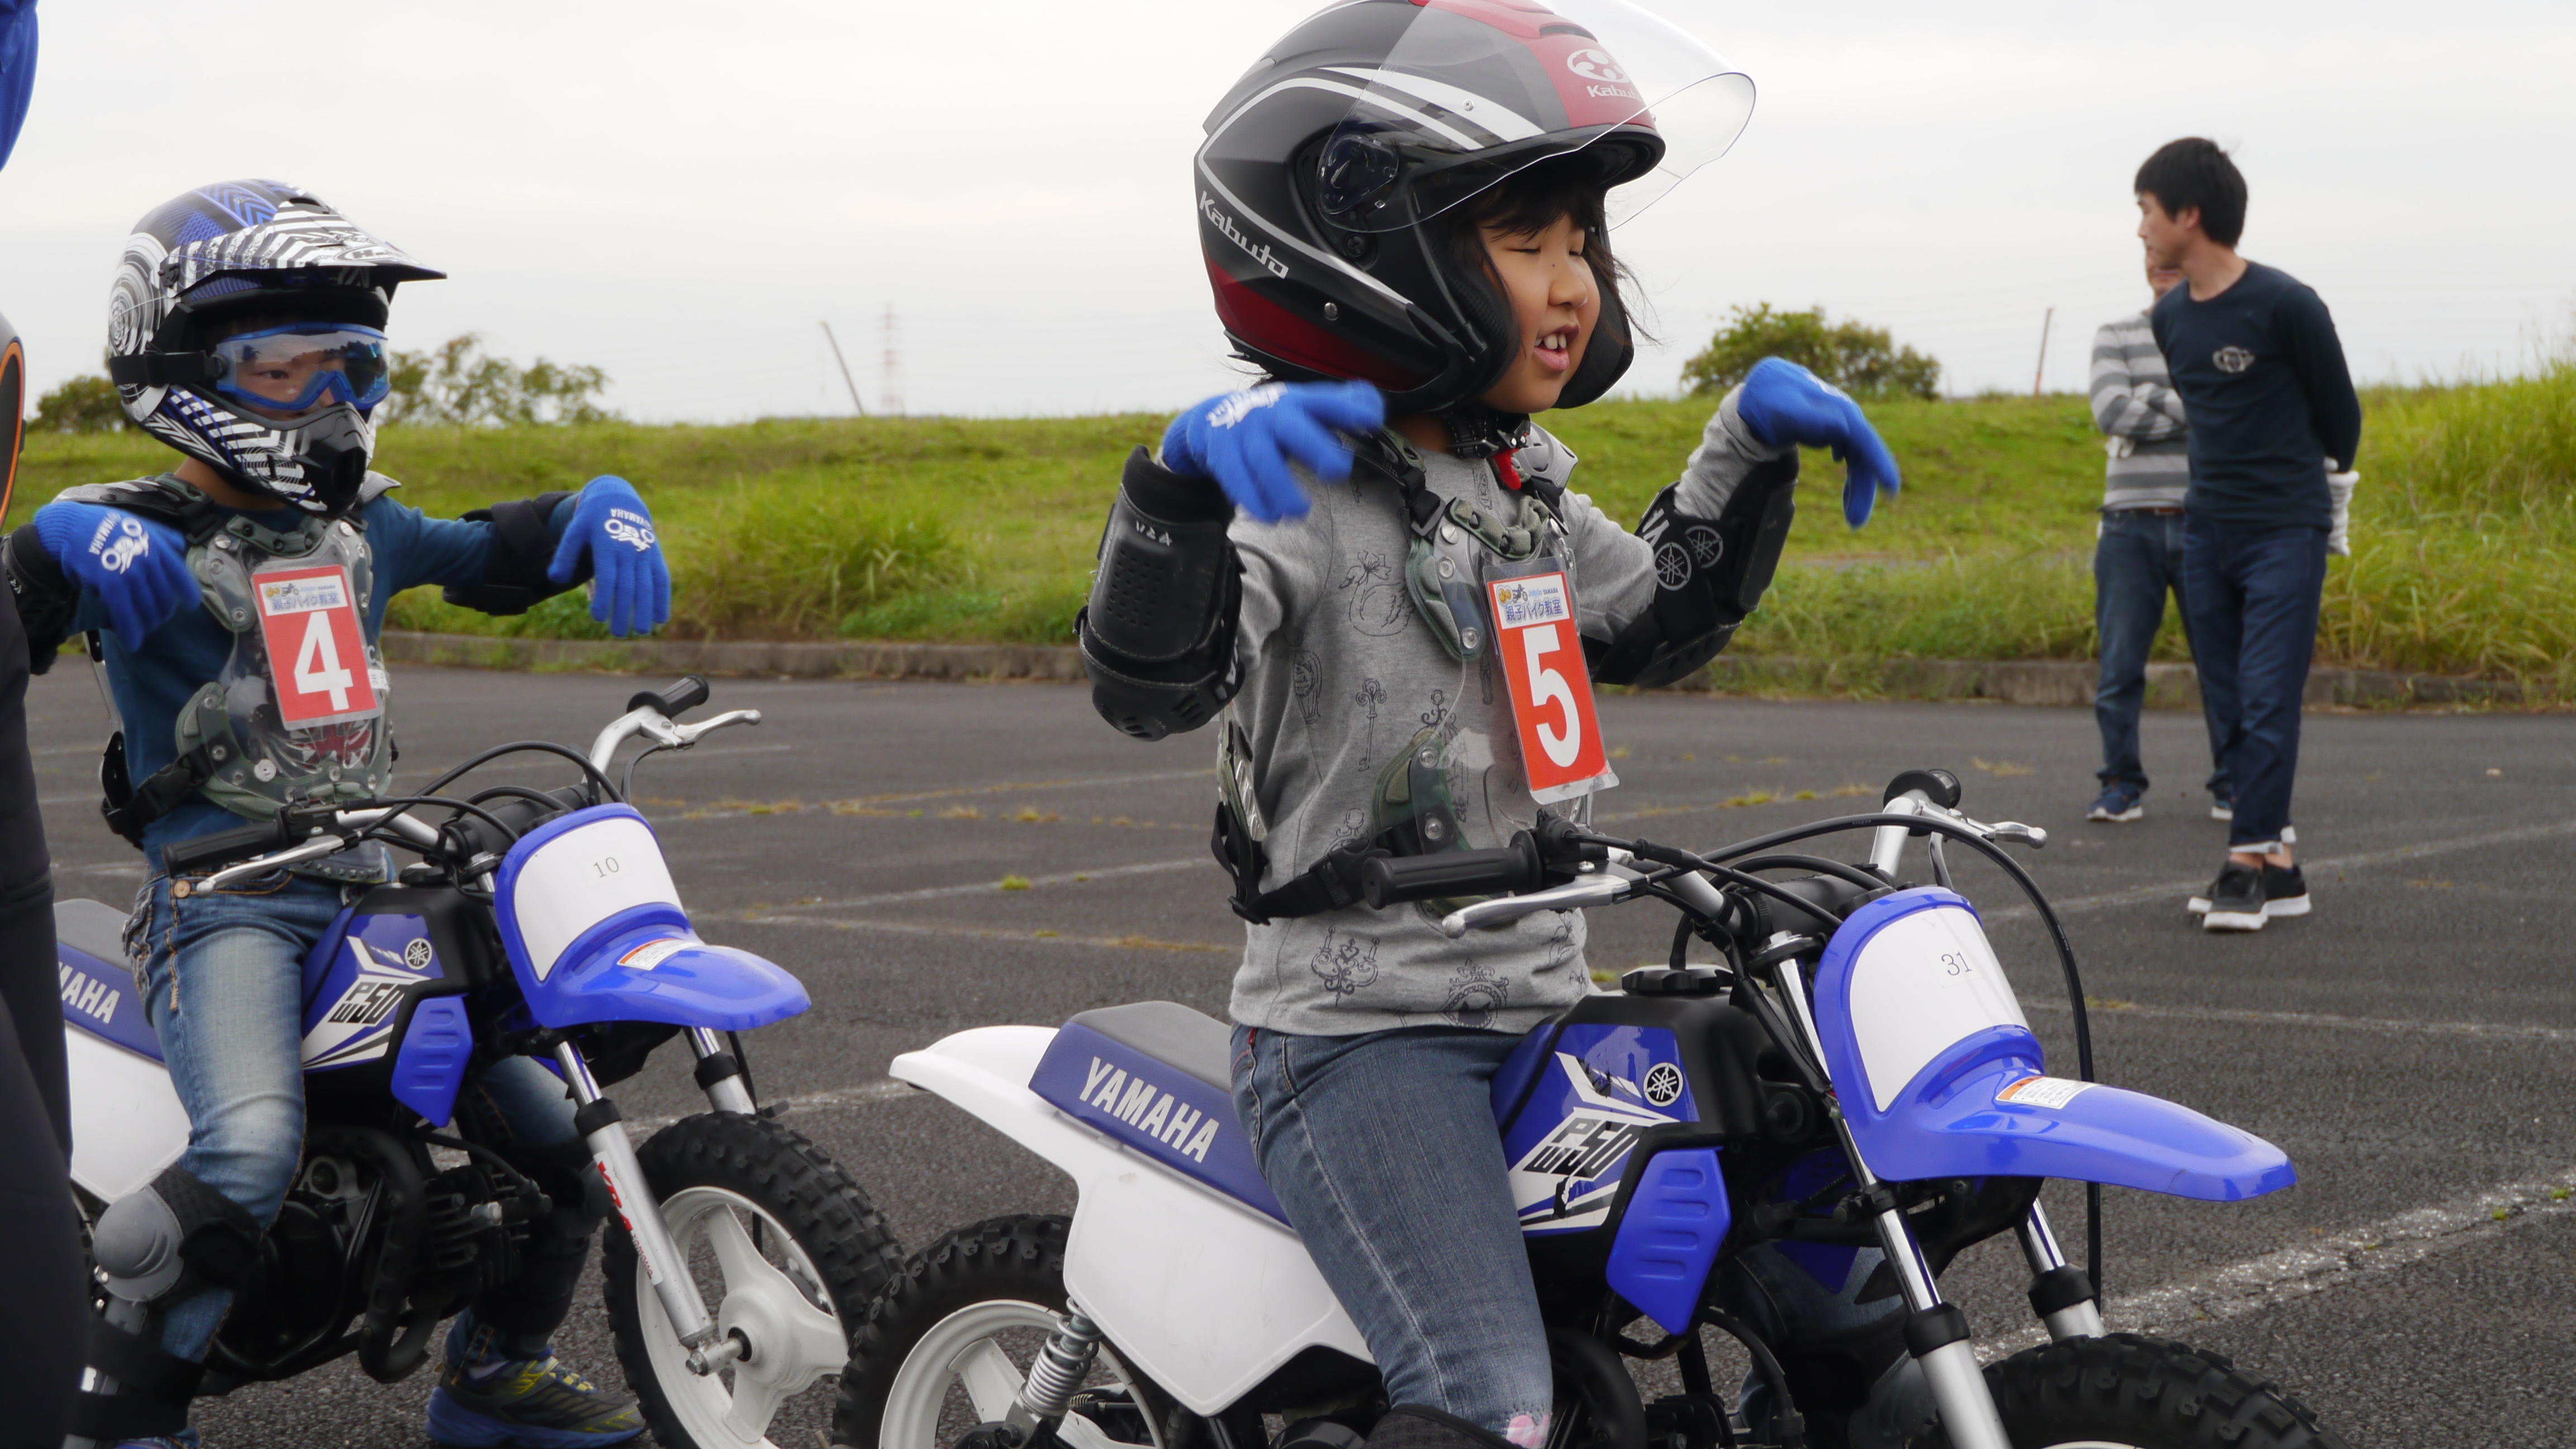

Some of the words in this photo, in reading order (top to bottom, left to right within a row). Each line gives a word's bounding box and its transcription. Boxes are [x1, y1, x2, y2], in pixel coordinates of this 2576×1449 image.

[1200, 191, 1289, 279] Kabuto
[1505, 599, 1563, 622] 親子バイク教室
[295, 610, 353, 711] 4
[1523, 624, 1580, 768] 5
[593, 856, 620, 878] 10
[1940, 951, 1973, 976] 31
[1079, 1056, 1220, 1163] YAMAHA
